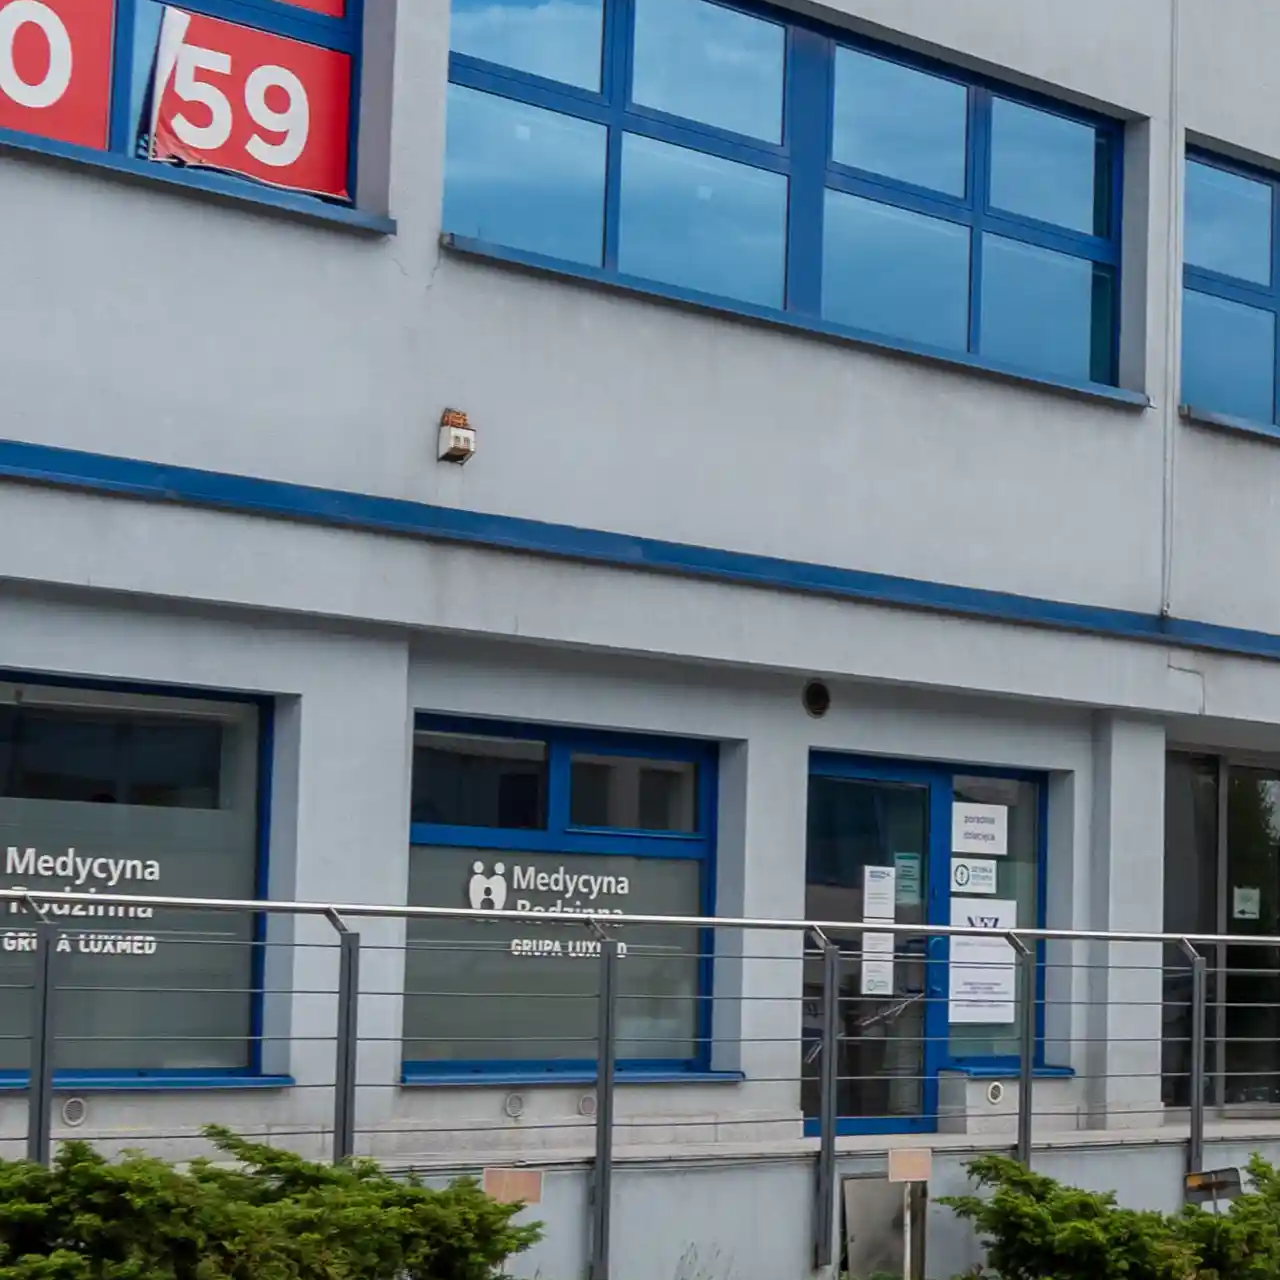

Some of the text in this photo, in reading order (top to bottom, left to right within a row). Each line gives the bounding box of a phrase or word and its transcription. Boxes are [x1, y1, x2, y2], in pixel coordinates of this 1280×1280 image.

[169, 45, 310, 167] 59
[5, 846, 160, 886] Medycyna
[513, 865, 629, 900] Medycyna
[78, 934, 157, 955] LUXMED
[511, 939, 563, 957] GRUPA
